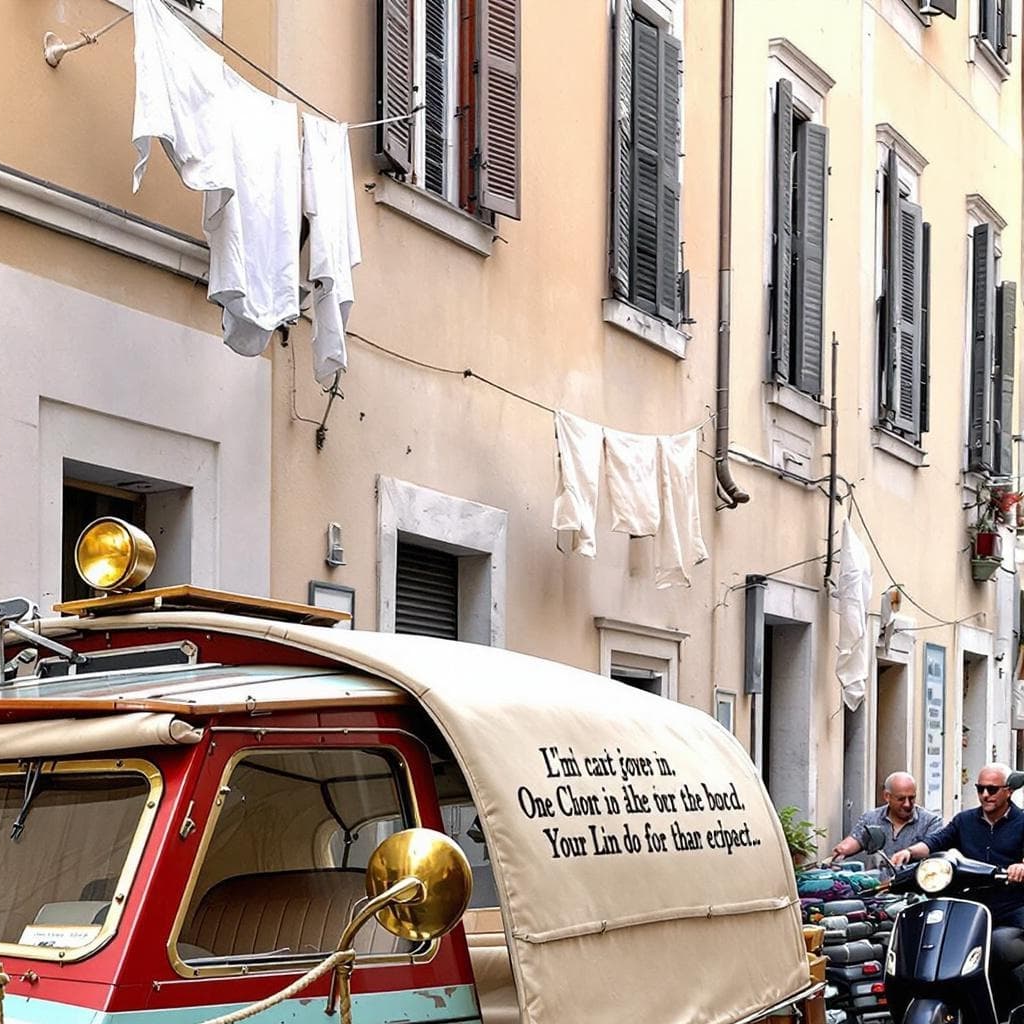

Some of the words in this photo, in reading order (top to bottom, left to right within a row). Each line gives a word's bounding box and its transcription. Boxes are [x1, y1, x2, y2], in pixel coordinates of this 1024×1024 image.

[517, 786, 555, 819] One
[542, 828, 588, 859] Your
[588, 825, 623, 856] Lin
[623, 823, 642, 853] do
[645, 822, 668, 853] for
